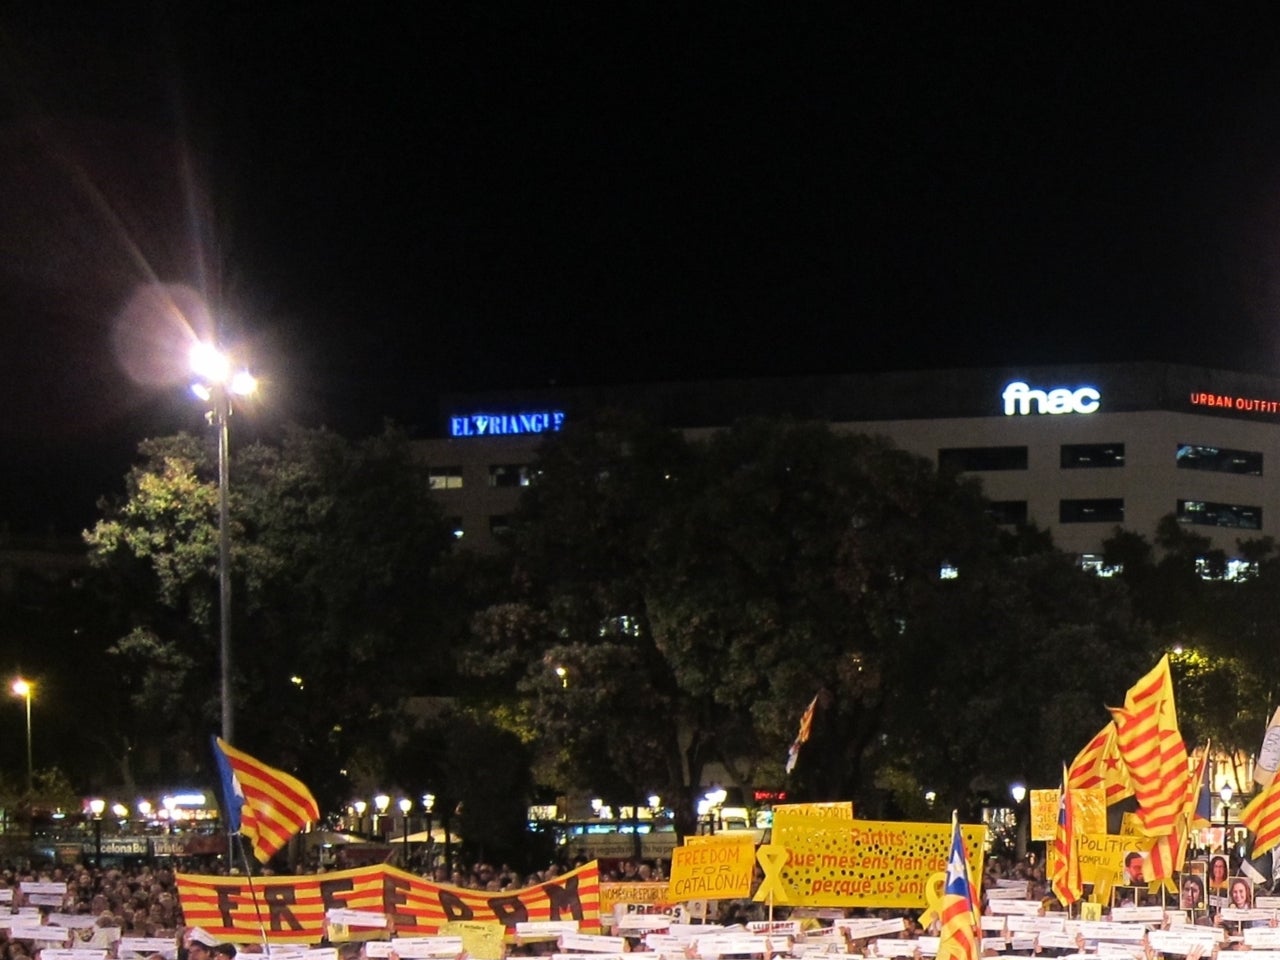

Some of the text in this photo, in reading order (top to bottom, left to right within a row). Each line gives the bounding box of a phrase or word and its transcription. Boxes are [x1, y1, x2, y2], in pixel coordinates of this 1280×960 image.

[1003, 382, 1100, 415] fnac
[1190, 393, 1232, 408] URBAN
[83, 843, 132, 854] Bacelona
[677, 847, 739, 867] FREEDOM
[862, 856, 889, 869] ens
[894, 852, 922, 870] han
[928, 854, 946, 871] de
[692, 865, 731, 876] FOR
[878, 881, 894, 894] us
[217, 874, 584, 932] FREEDOM
[627, 904, 681, 919] PRESOS
